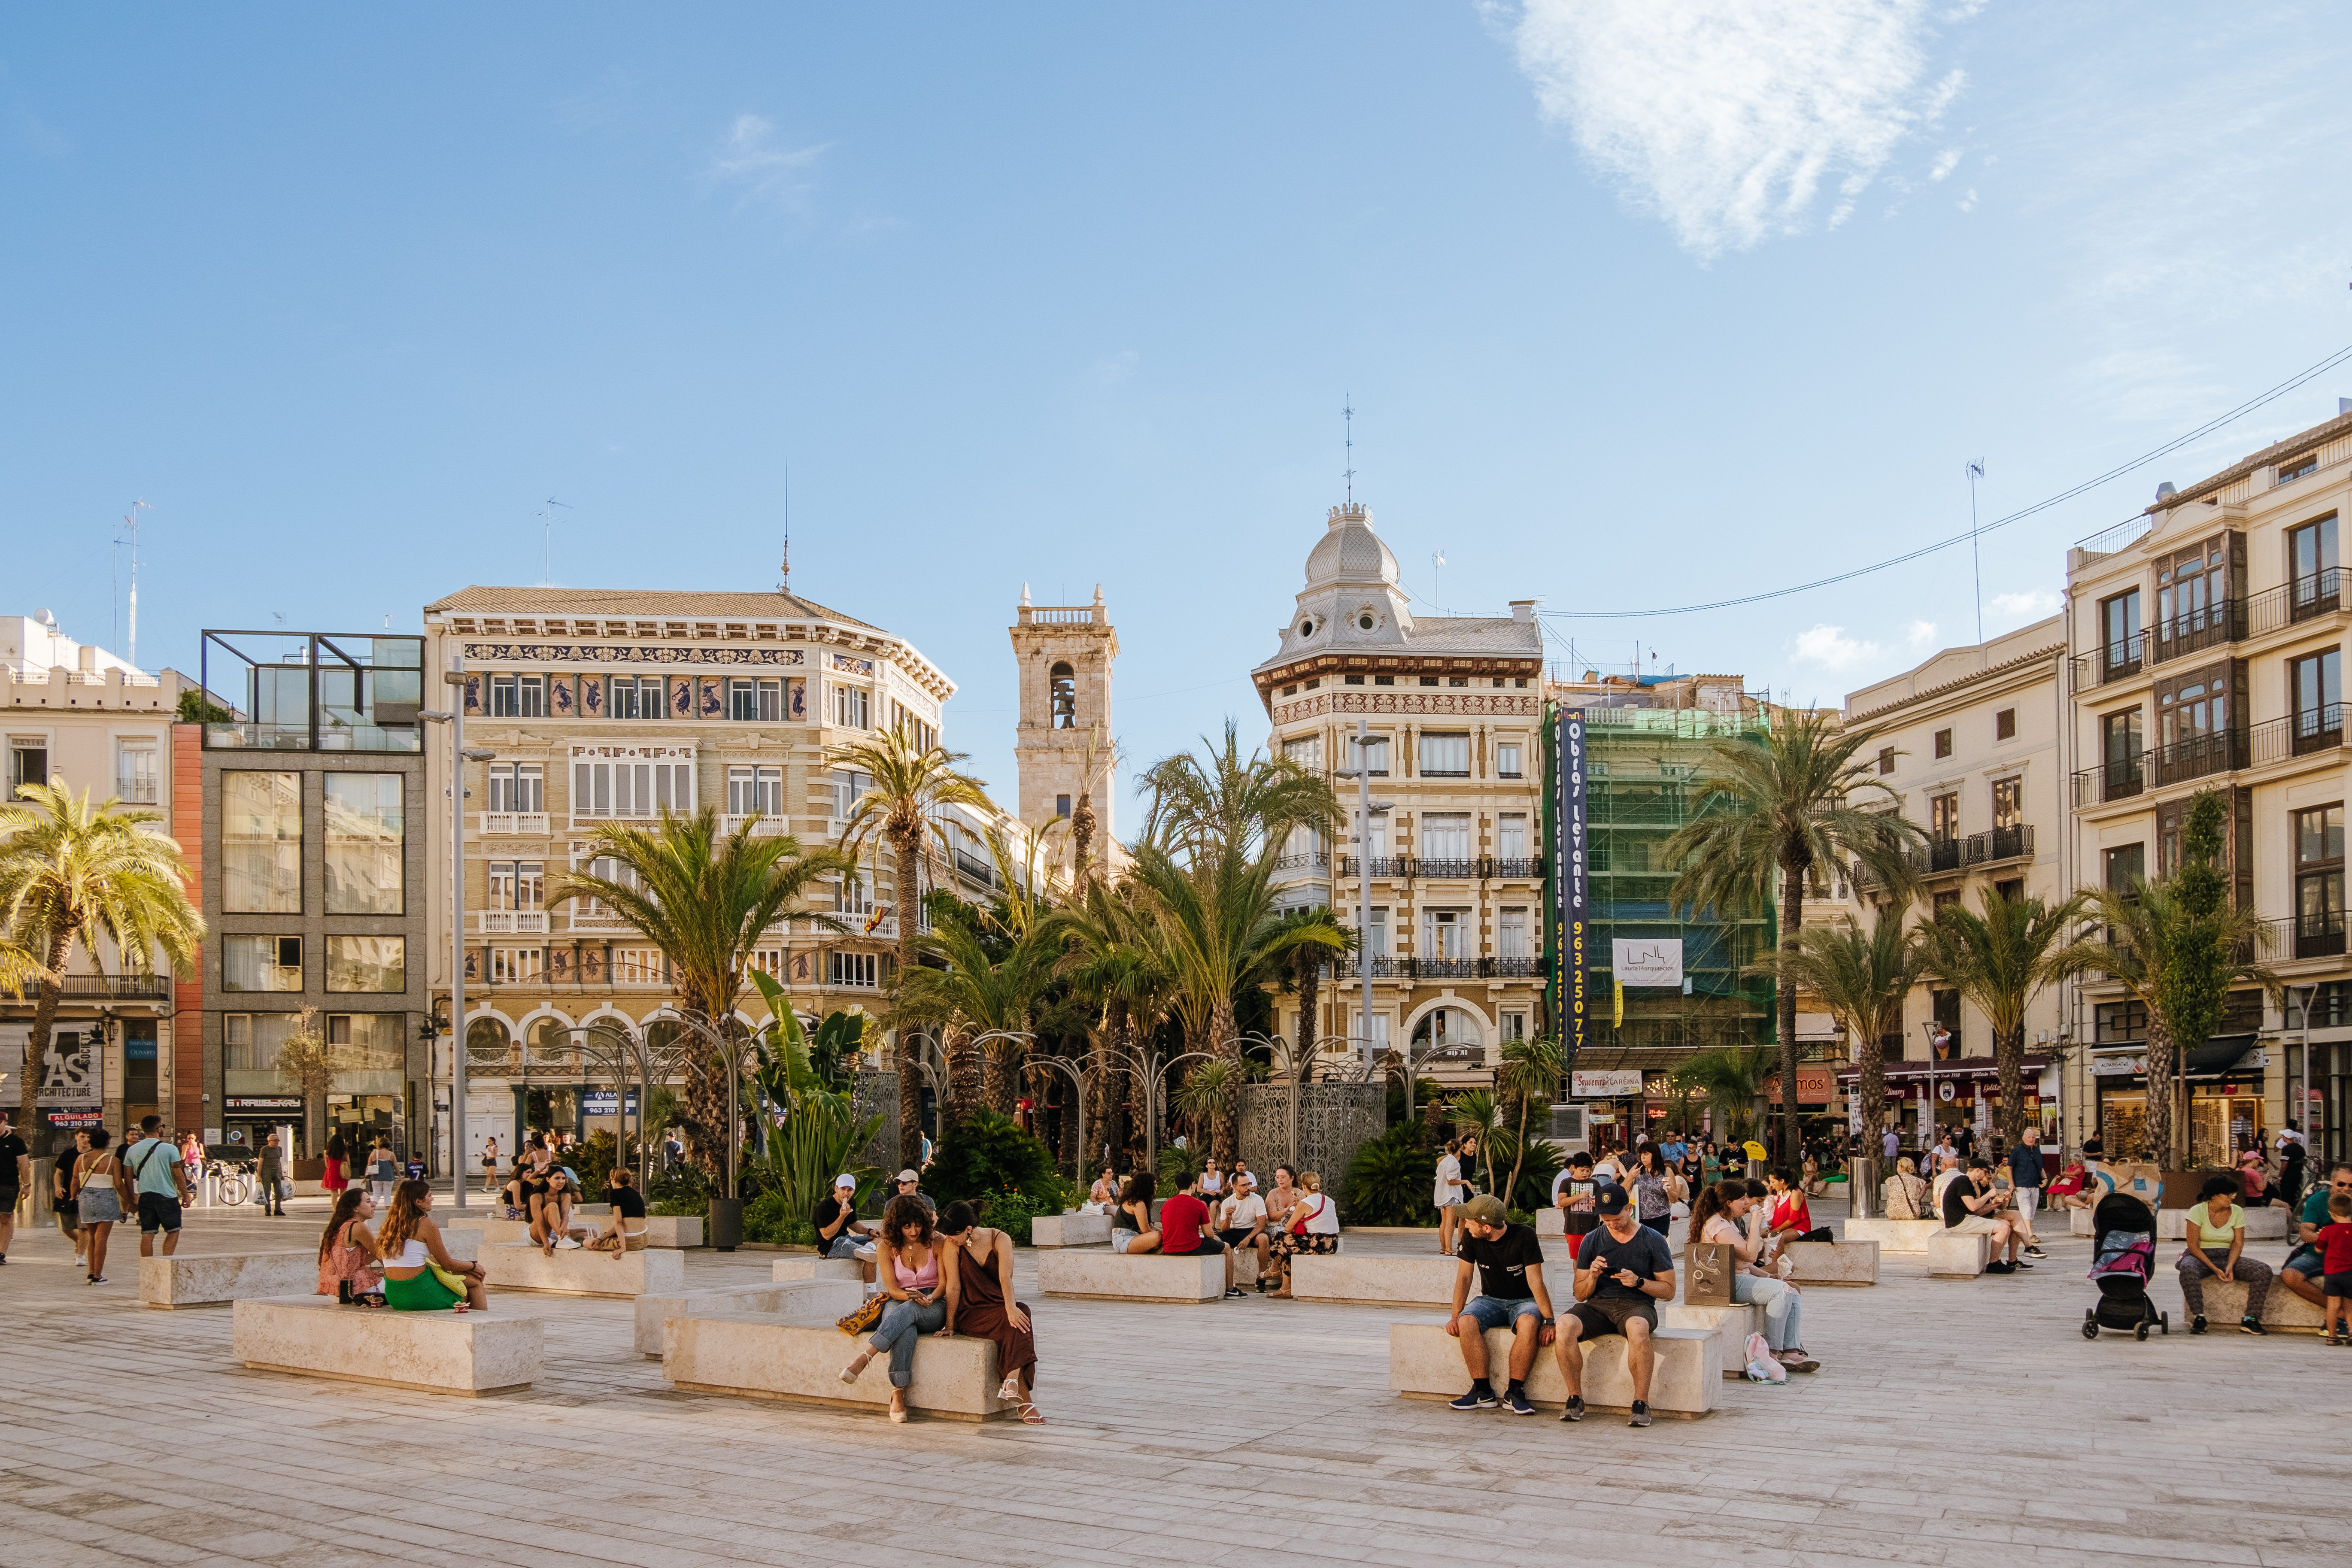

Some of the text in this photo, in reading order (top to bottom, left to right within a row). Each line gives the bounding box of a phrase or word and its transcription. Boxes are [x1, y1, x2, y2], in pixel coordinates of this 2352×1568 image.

[1569, 723, 1581, 798] Obras
[80, 1032, 91, 1065] SOCIETY
[37, 1087, 91, 1097] RCHITECTURE
[226, 1099, 300, 1107] STRAWBERRY
[55, 1113, 99, 1121] ALQUILADO
[413, 1170, 420, 1181] 7
